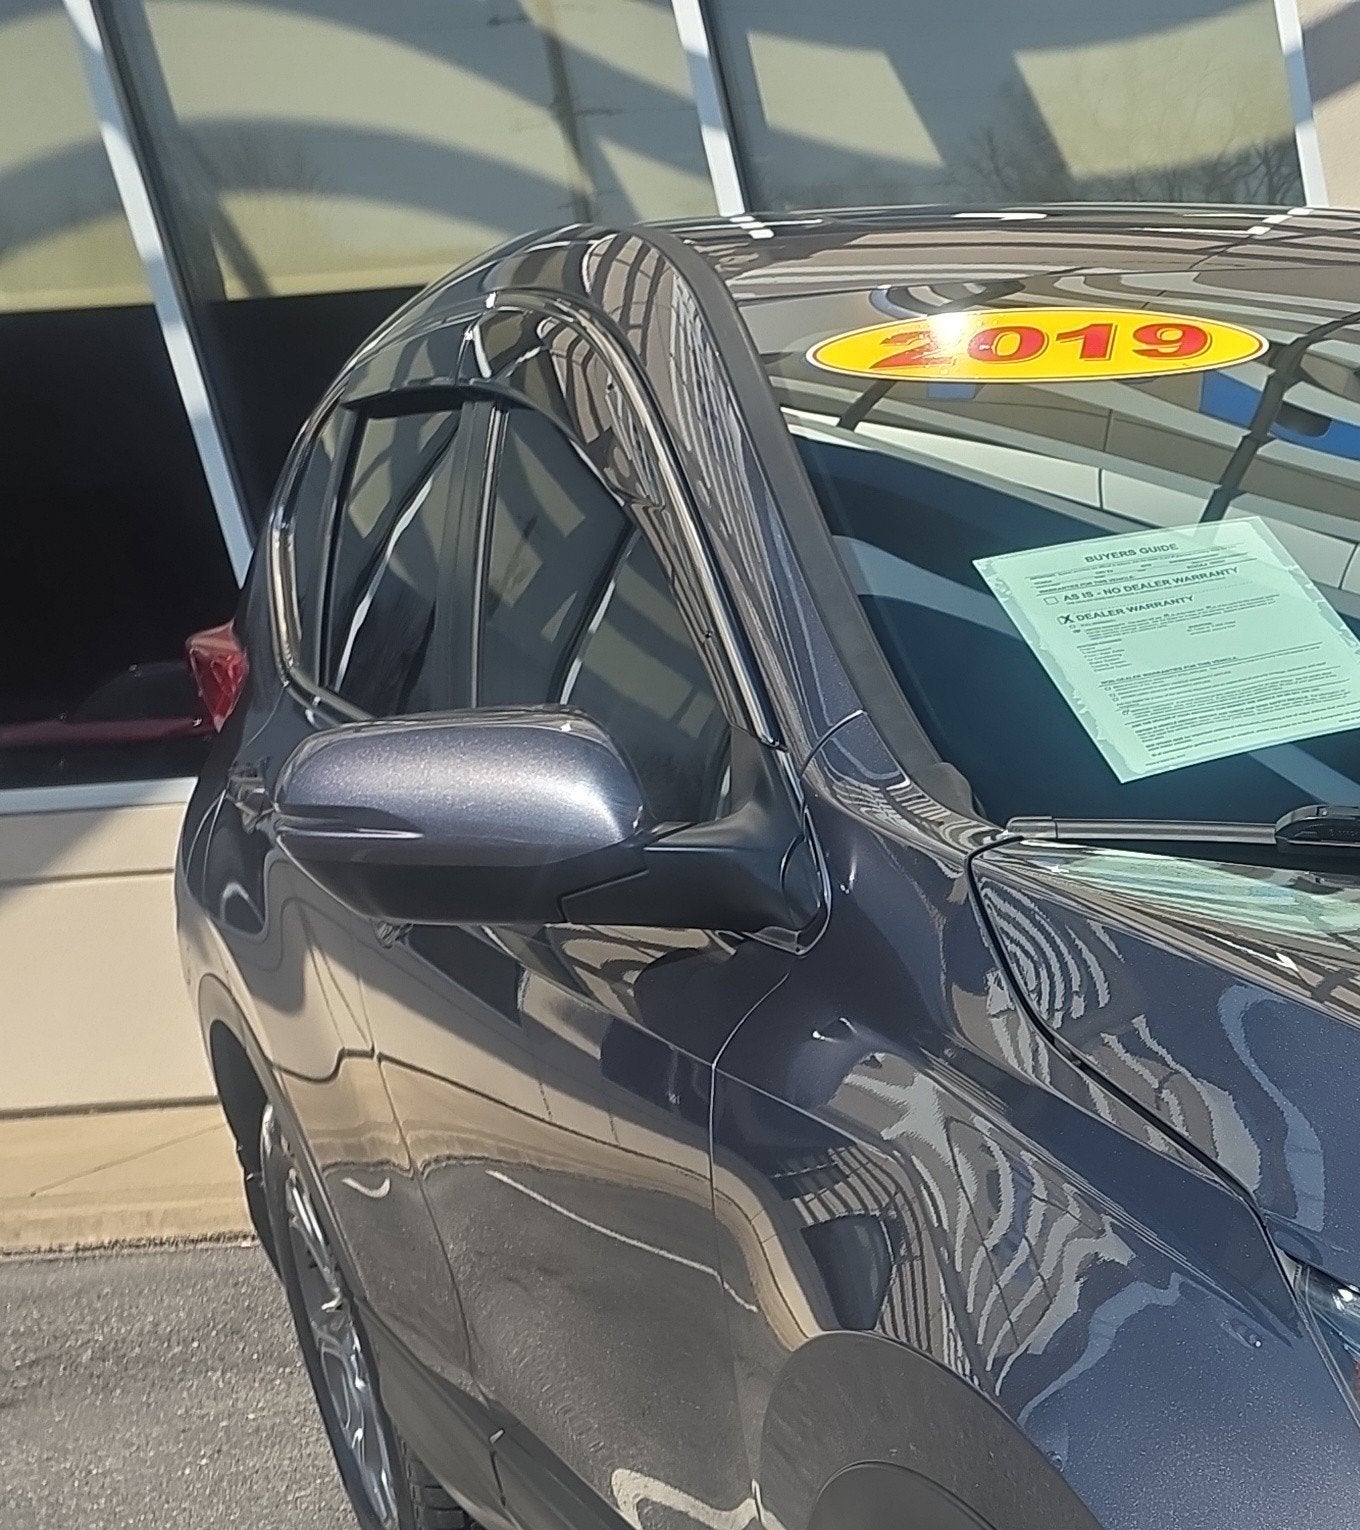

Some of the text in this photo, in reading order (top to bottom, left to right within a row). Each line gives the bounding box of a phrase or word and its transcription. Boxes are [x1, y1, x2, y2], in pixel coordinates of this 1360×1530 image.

[868, 322, 1213, 370] 2019
[1084, 549, 1137, 563] BUYERS
[1139, 543, 1179, 555] GUIDE
[1064, 593, 1080, 602] AS
[1081, 591, 1094, 599] IS
[1103, 587, 1121, 595] NO
[1123, 579, 1171, 592] DEALER
[1172, 566, 1238, 584] WARRANTY
[1076, 608, 1125, 622] DEALER
[1126, 594, 1194, 613] WARRANTY
